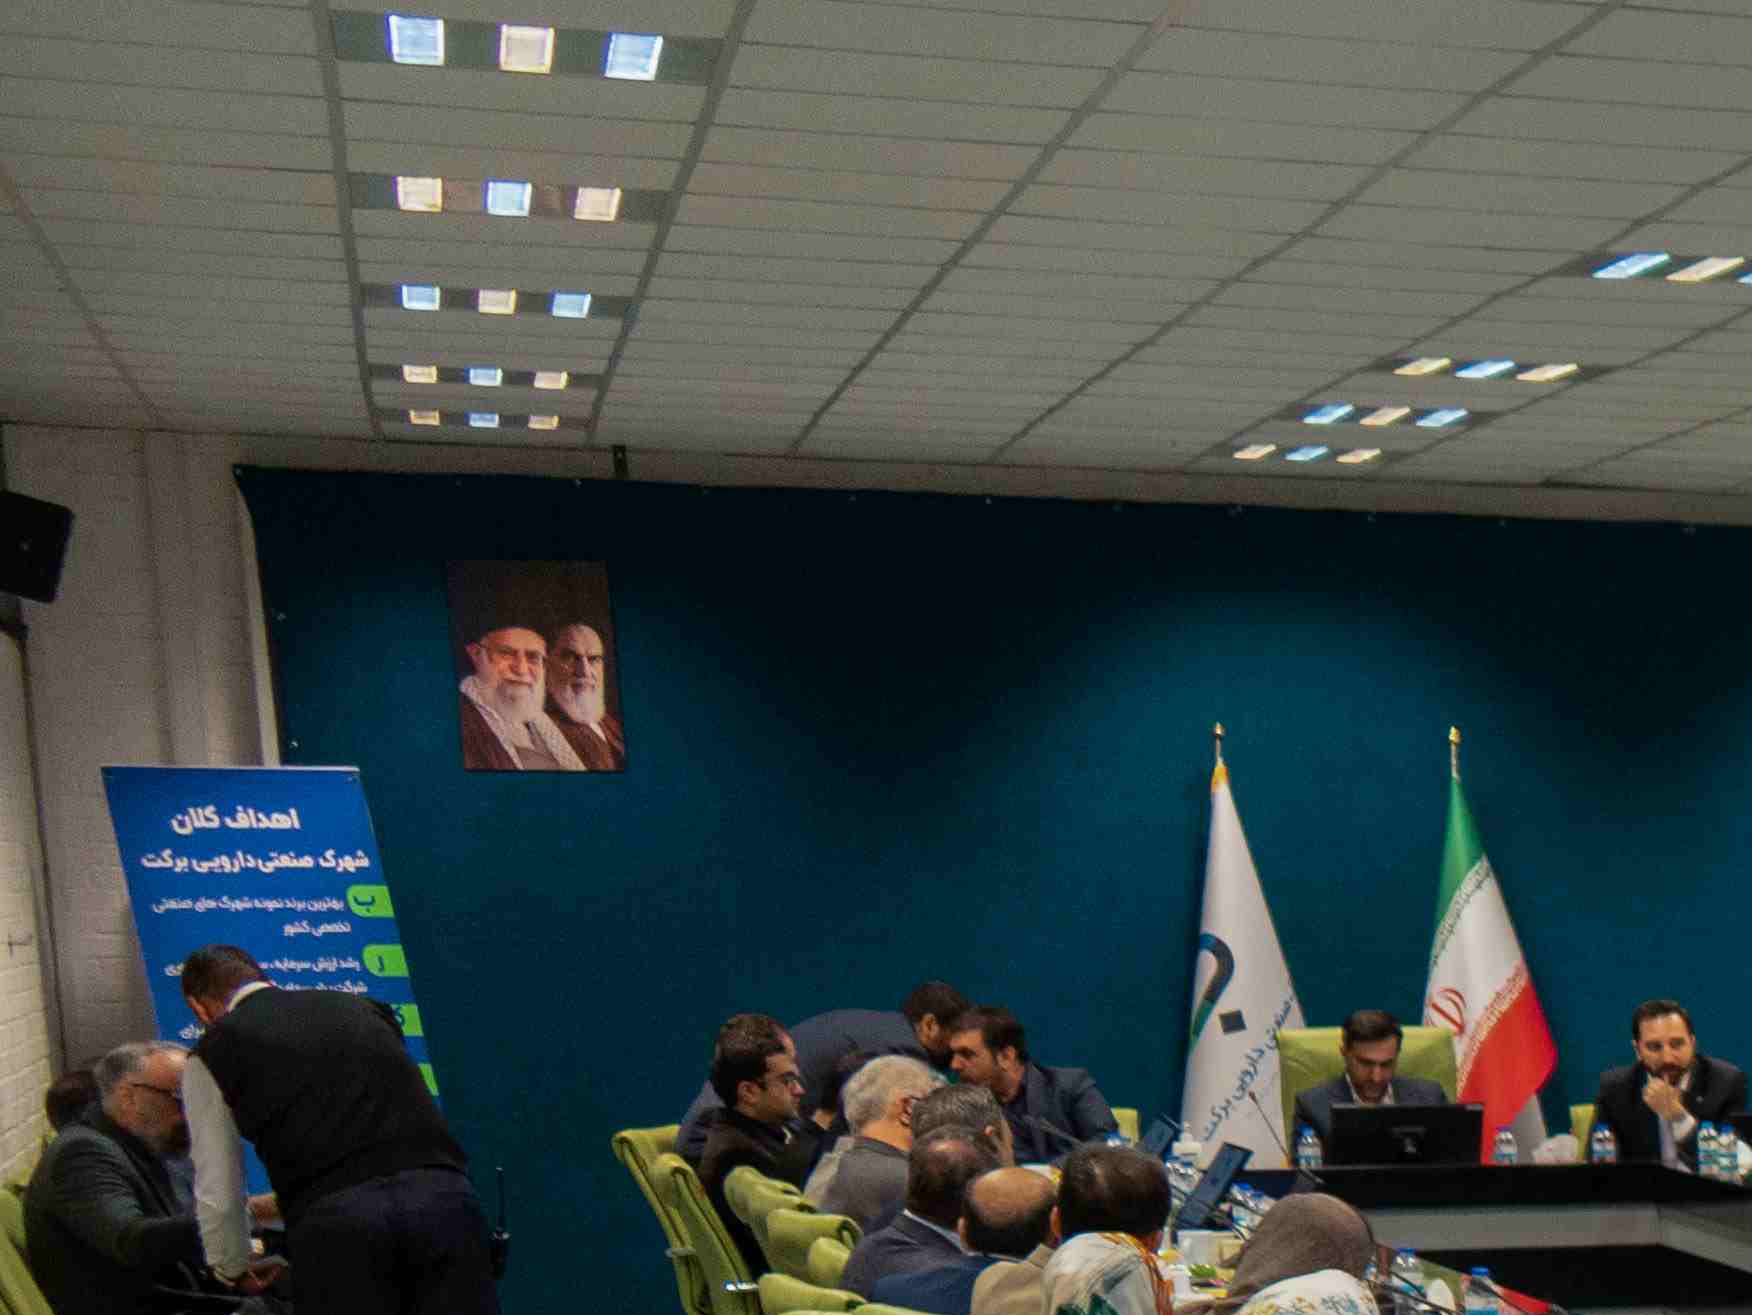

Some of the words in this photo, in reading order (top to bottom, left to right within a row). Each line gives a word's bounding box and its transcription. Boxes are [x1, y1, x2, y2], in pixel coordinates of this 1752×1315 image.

[169, 804, 221, 835] کلان
[224, 805, 301, 830] اهداف
[141, 848, 190, 873] برکت
[191, 850, 257, 873] دارویی
[257, 850, 315, 873] صنعتی
[319, 848, 371, 873] شهرک
